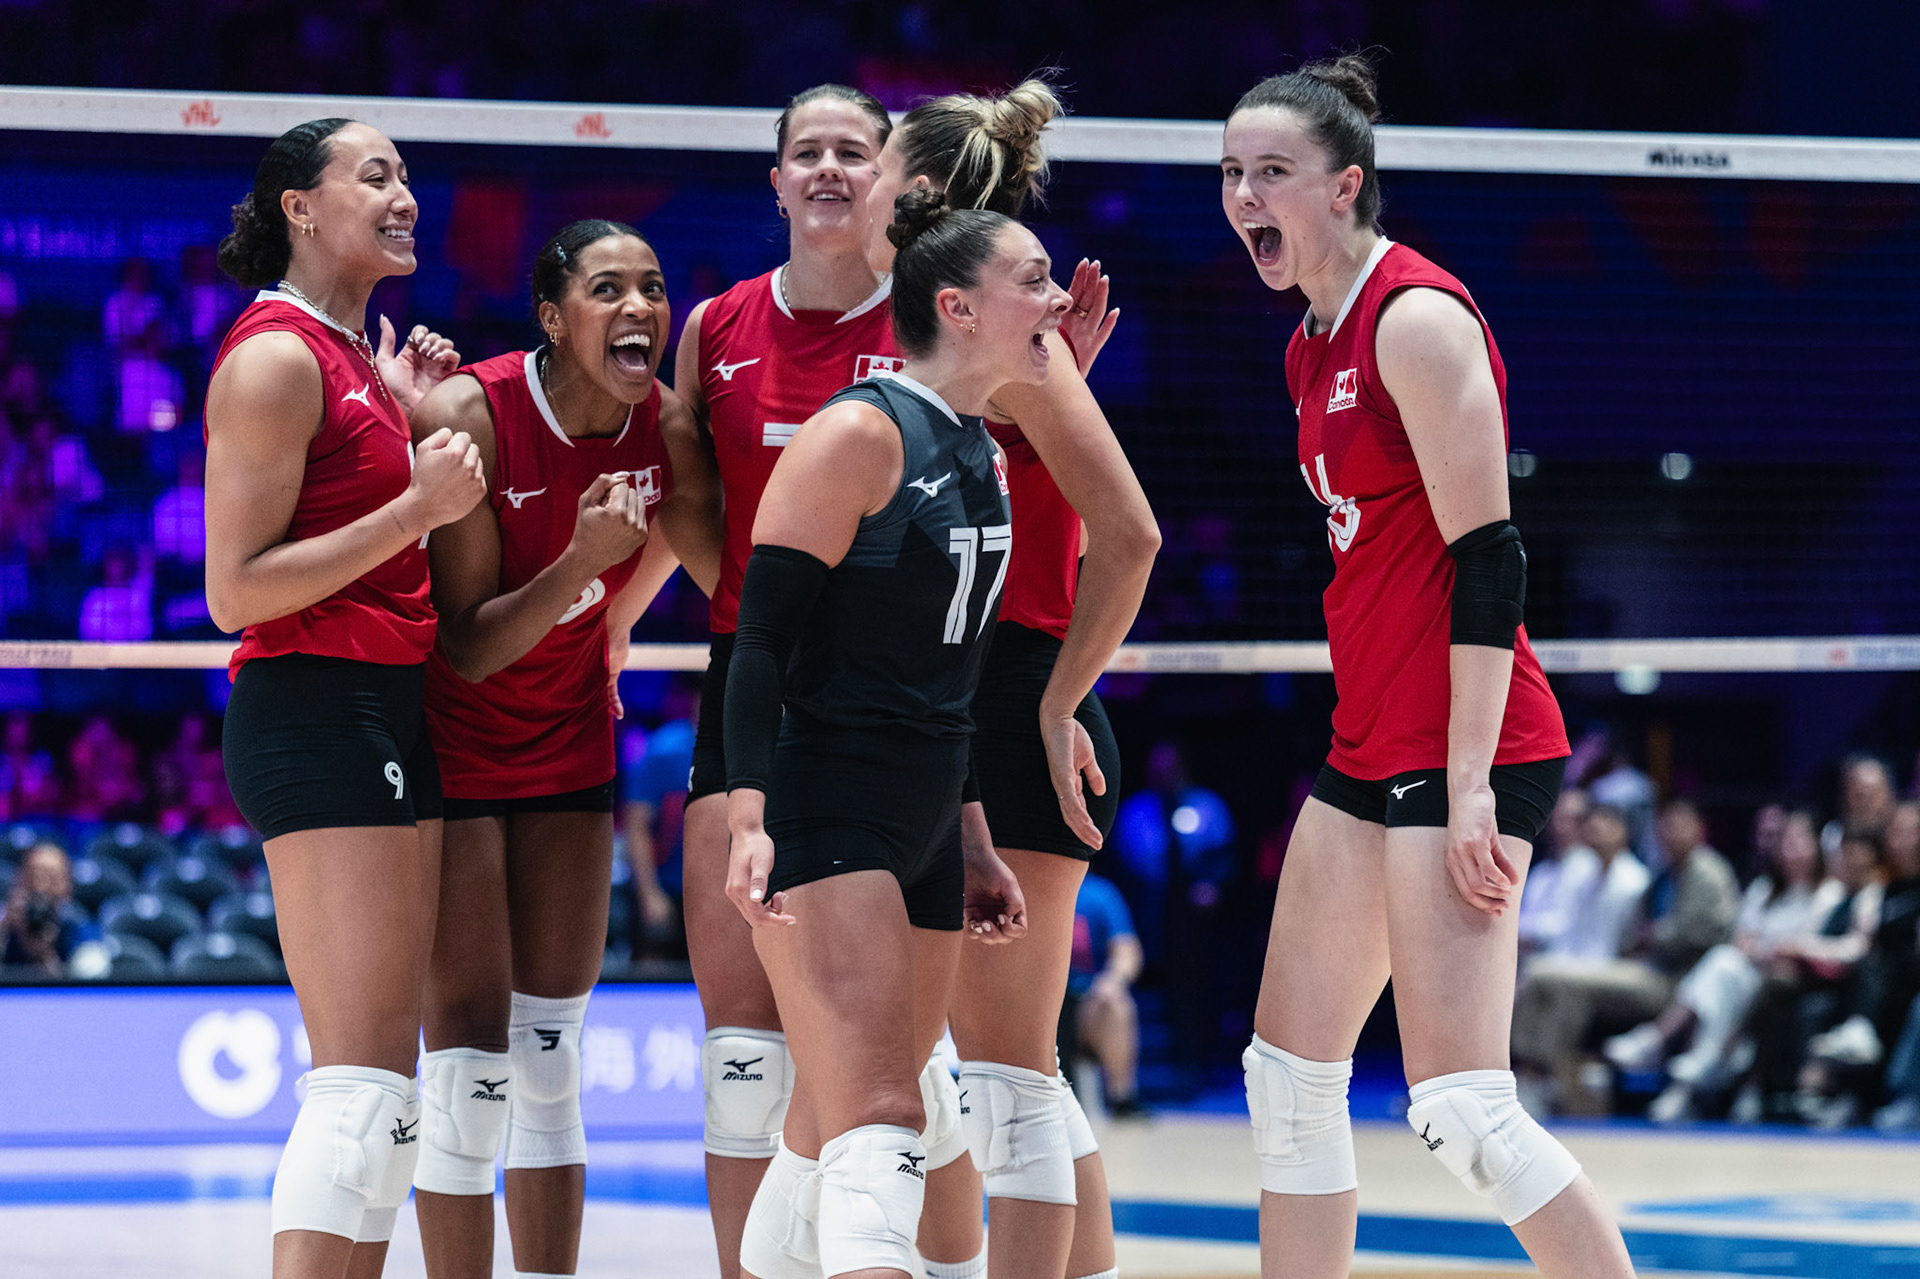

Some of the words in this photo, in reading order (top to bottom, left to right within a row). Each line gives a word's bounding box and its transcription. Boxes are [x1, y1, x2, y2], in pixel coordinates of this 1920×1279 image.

[1328, 397, 1355, 411] Canada
[943, 523, 1012, 644] 17
[384, 761, 404, 800] 9
